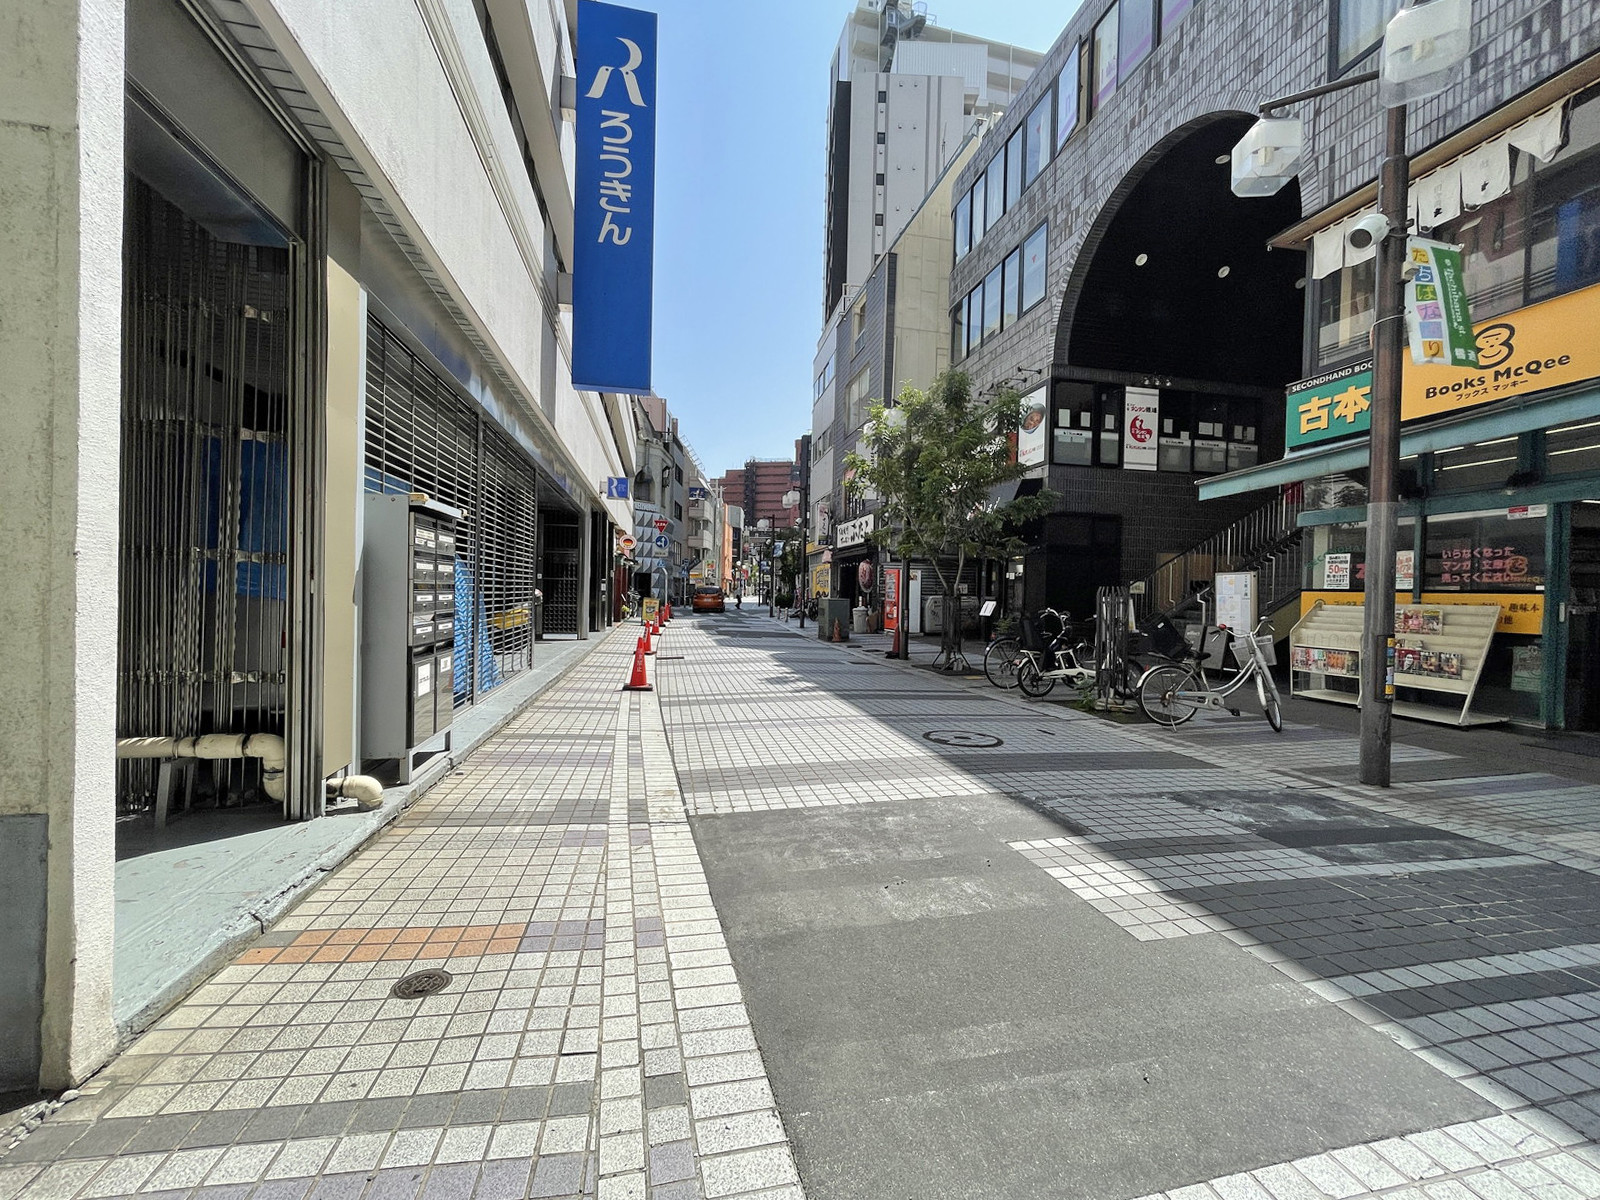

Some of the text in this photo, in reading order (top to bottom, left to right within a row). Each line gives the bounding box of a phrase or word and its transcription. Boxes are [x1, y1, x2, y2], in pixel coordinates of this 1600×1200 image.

[598, 109, 633, 246] ろうきん
[1411, 249, 1442, 358] たちばなり
[1292, 368, 1352, 393] SECONDHAND
[1425, 375, 1486, 400] Books
[1493, 354, 1571, 383] McQee
[1456, 379, 1529, 401] ブックス マッキー
[1298, 385, 1371, 434] 古本
[1442, 546, 1514, 559] いらなくなった
